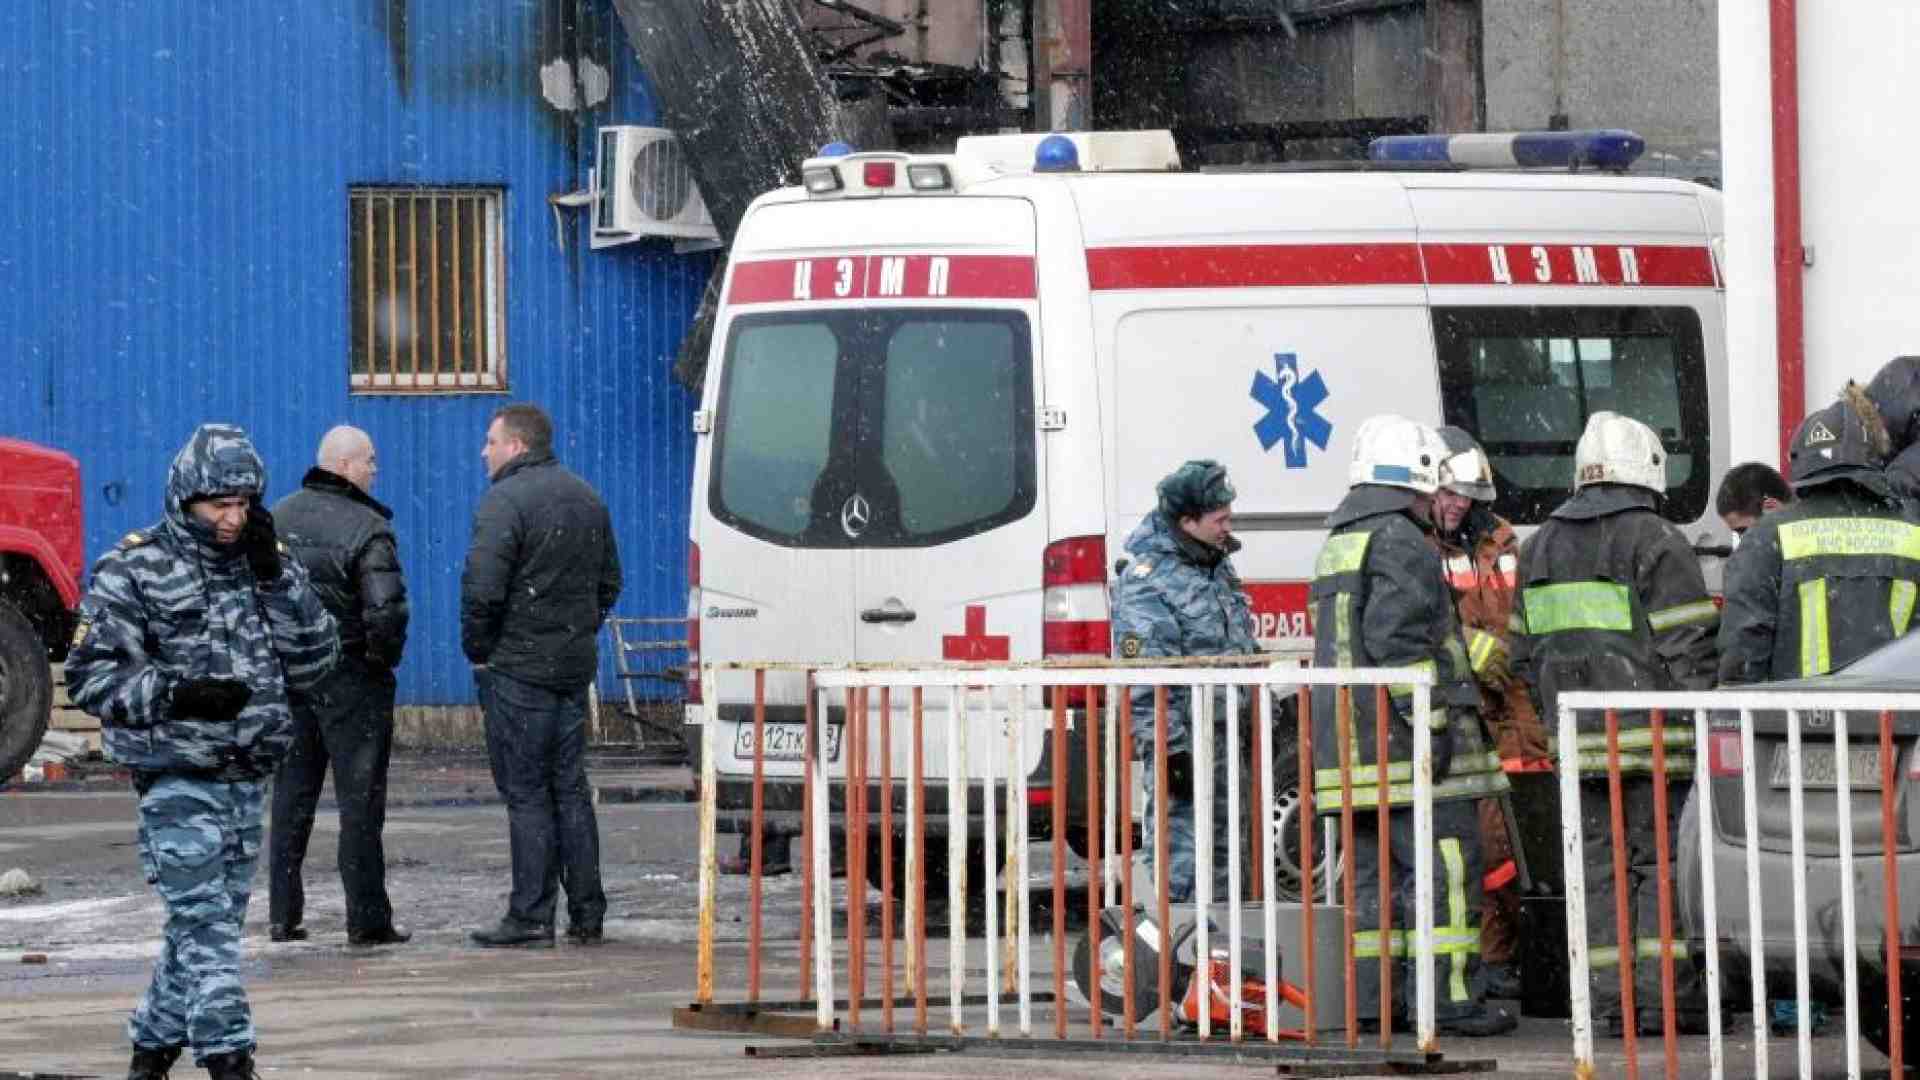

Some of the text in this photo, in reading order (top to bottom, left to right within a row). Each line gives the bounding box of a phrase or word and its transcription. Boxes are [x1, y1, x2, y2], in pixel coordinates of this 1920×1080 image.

[793, 257, 949, 299] ЦЭМП
[1488, 246, 1639, 284] ЦЭМП
[1250, 611, 1306, 640] ОРАЯ
